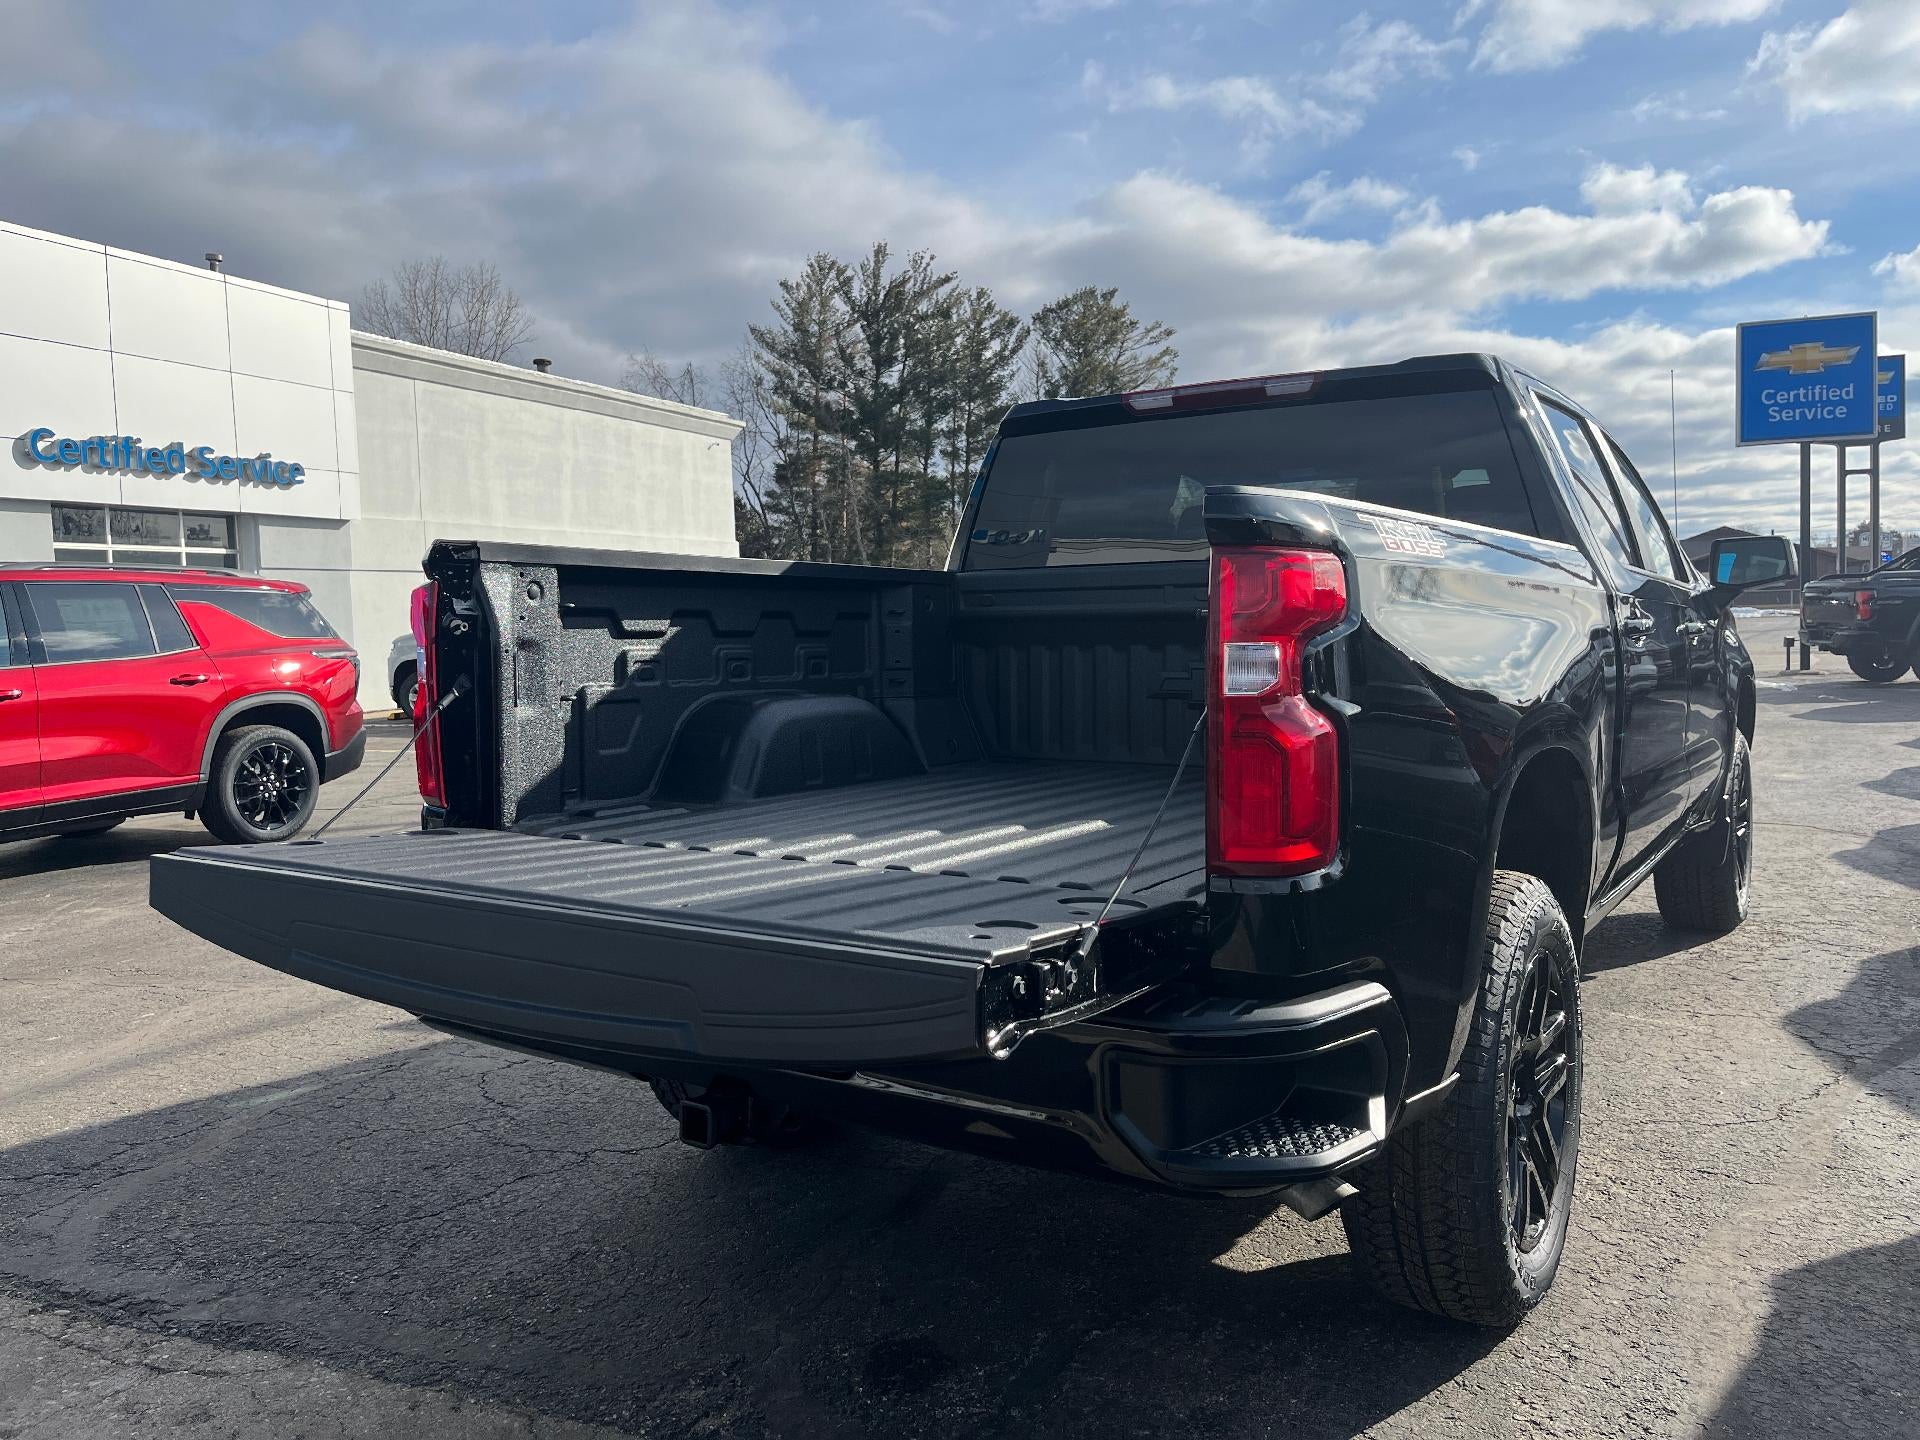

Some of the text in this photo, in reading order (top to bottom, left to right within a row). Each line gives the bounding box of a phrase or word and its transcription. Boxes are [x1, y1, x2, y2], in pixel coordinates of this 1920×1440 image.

[1761, 384, 1854, 405] Certified
[1768, 403, 1847, 422] Service
[27, 427, 306, 485] Certified Service
[1356, 512, 1447, 546] TRAIL
[1380, 534, 1445, 558] BOSS
